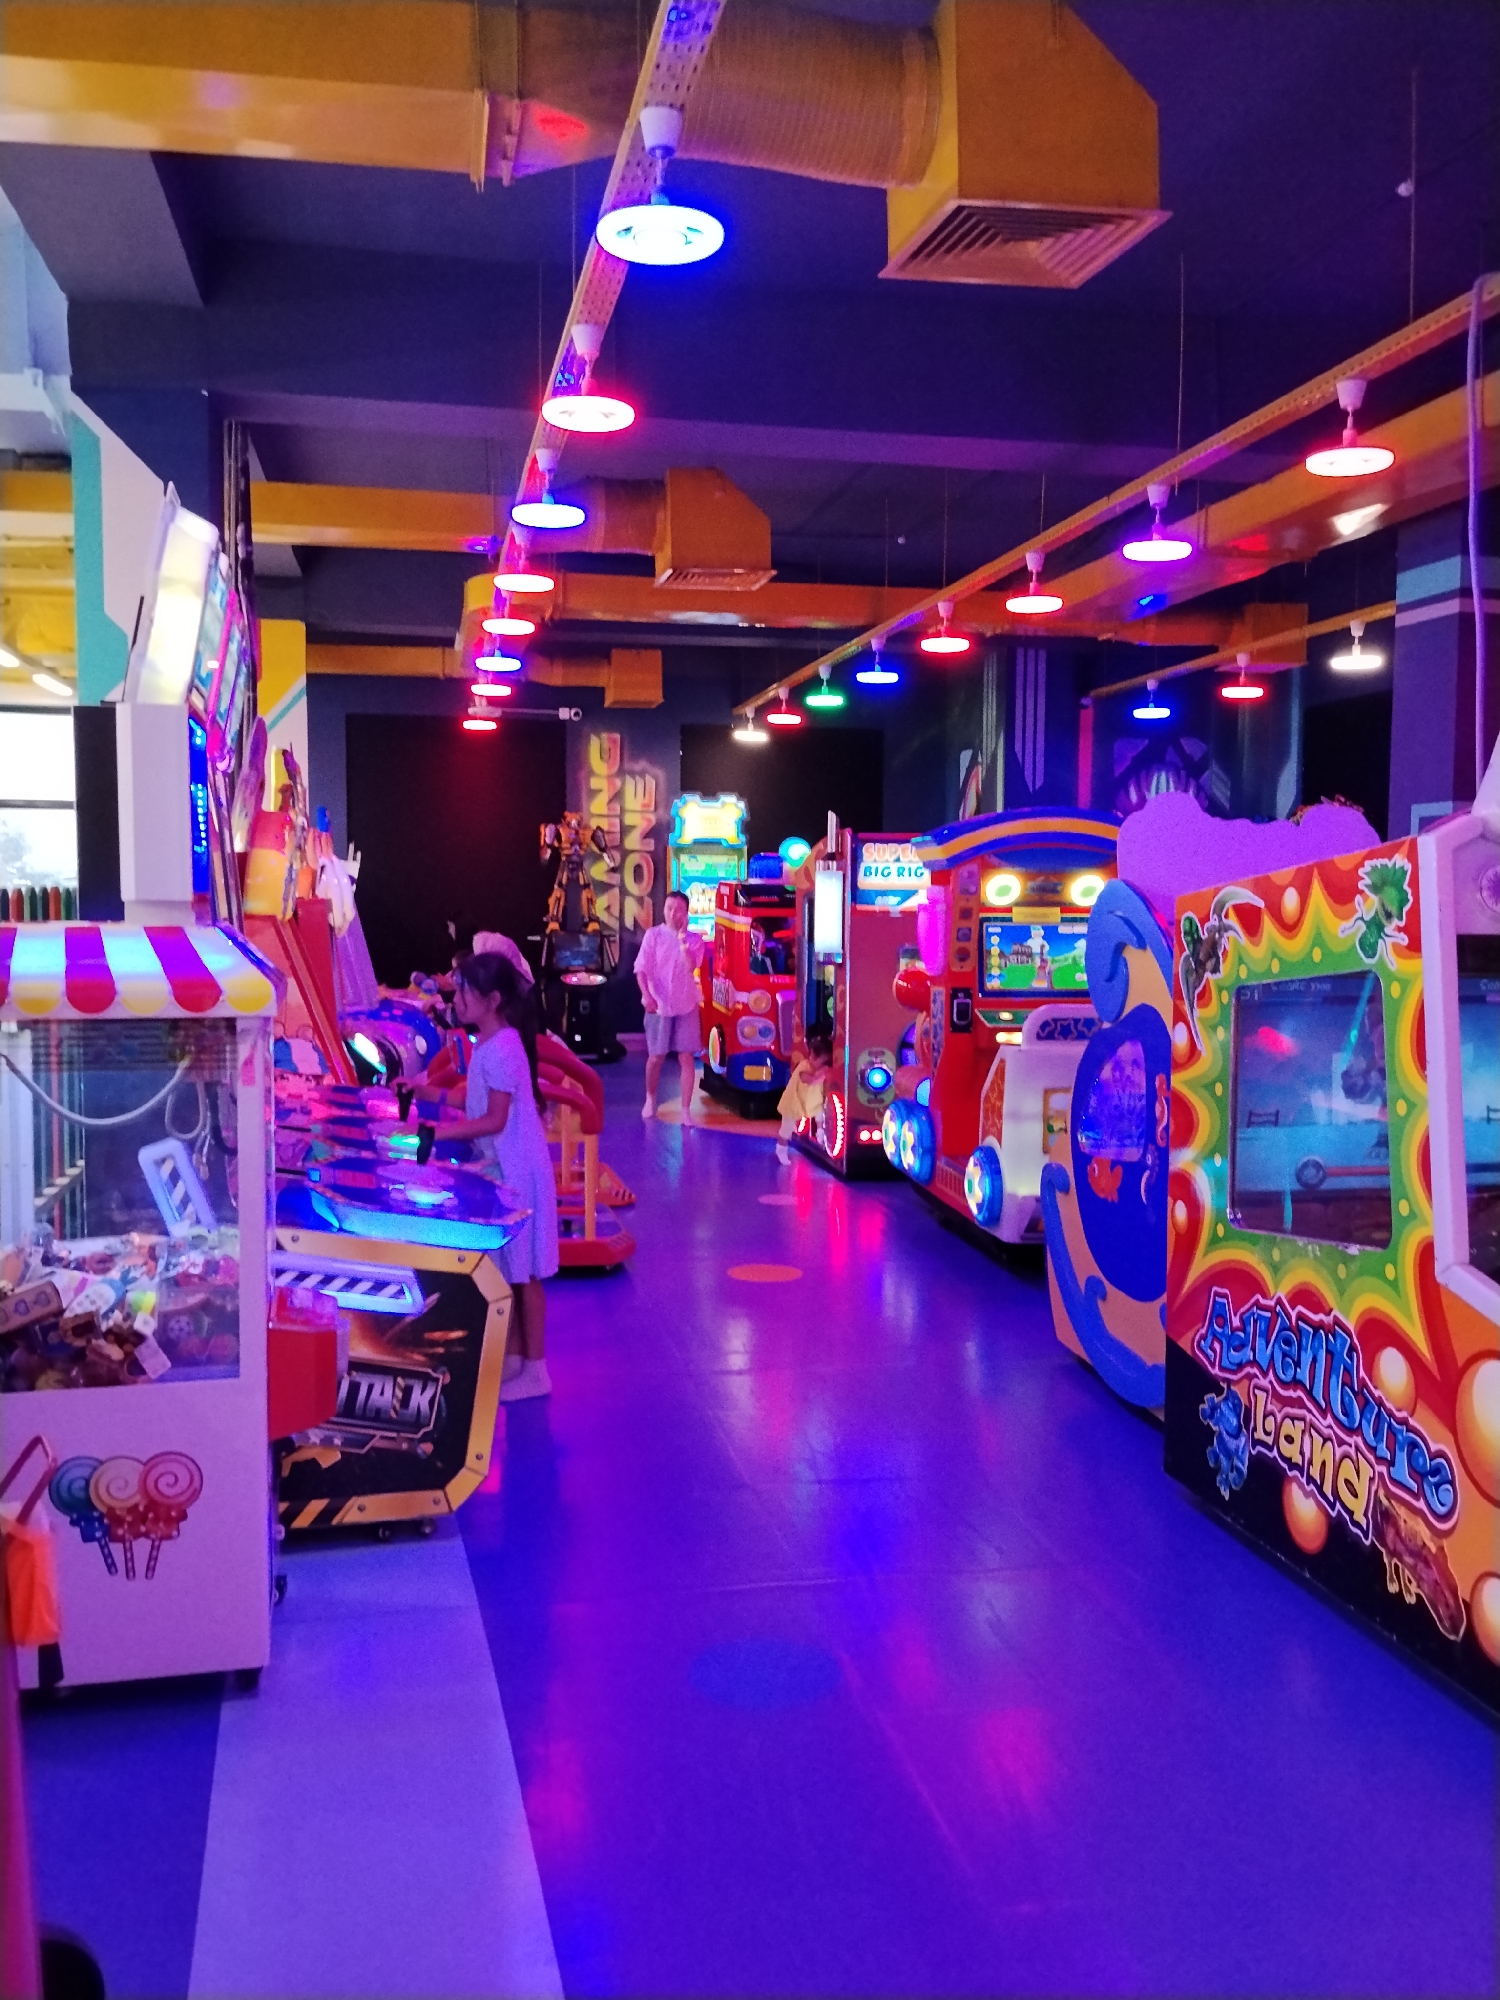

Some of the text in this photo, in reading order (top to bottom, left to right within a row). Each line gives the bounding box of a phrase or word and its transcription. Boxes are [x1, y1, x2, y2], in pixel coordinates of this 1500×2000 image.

[624, 774, 656, 932] ZONE
[863, 865, 925, 878] BIG RIG
[1253, 1387, 1374, 1528] Land
